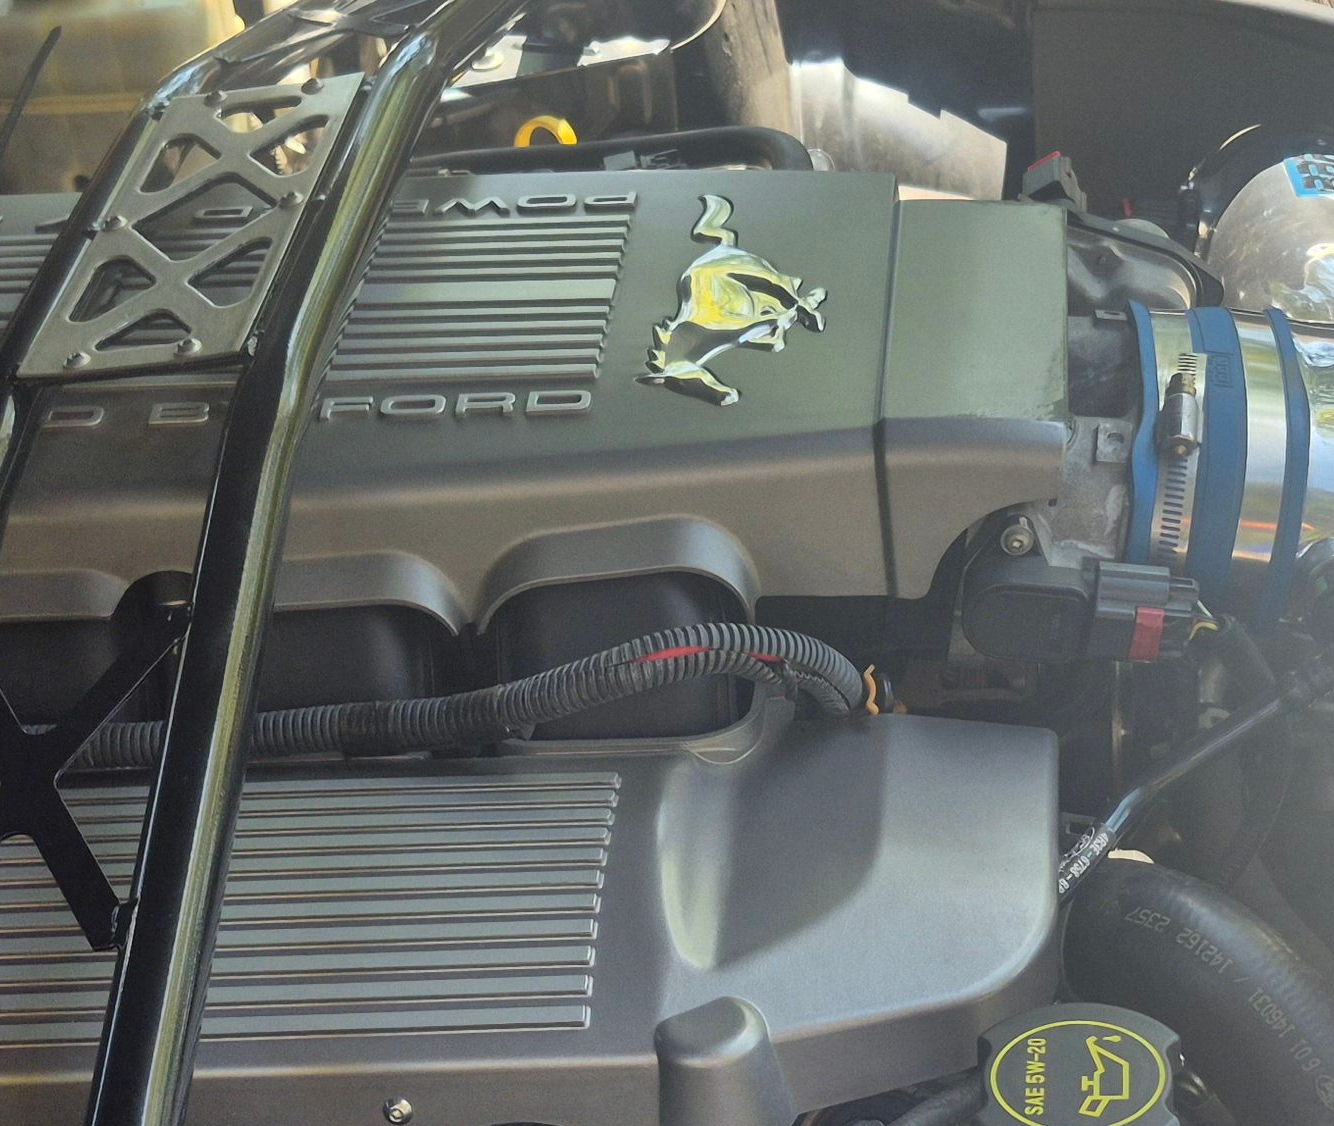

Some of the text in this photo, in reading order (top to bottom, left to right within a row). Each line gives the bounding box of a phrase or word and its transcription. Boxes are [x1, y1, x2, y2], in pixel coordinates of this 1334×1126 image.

[317, 389, 595, 424] FORD
[1124, 906, 1172, 932] 2357
[1175, 927, 1234, 973] 142162
[1024, 1037, 1047, 1116] SAE 5W-20
